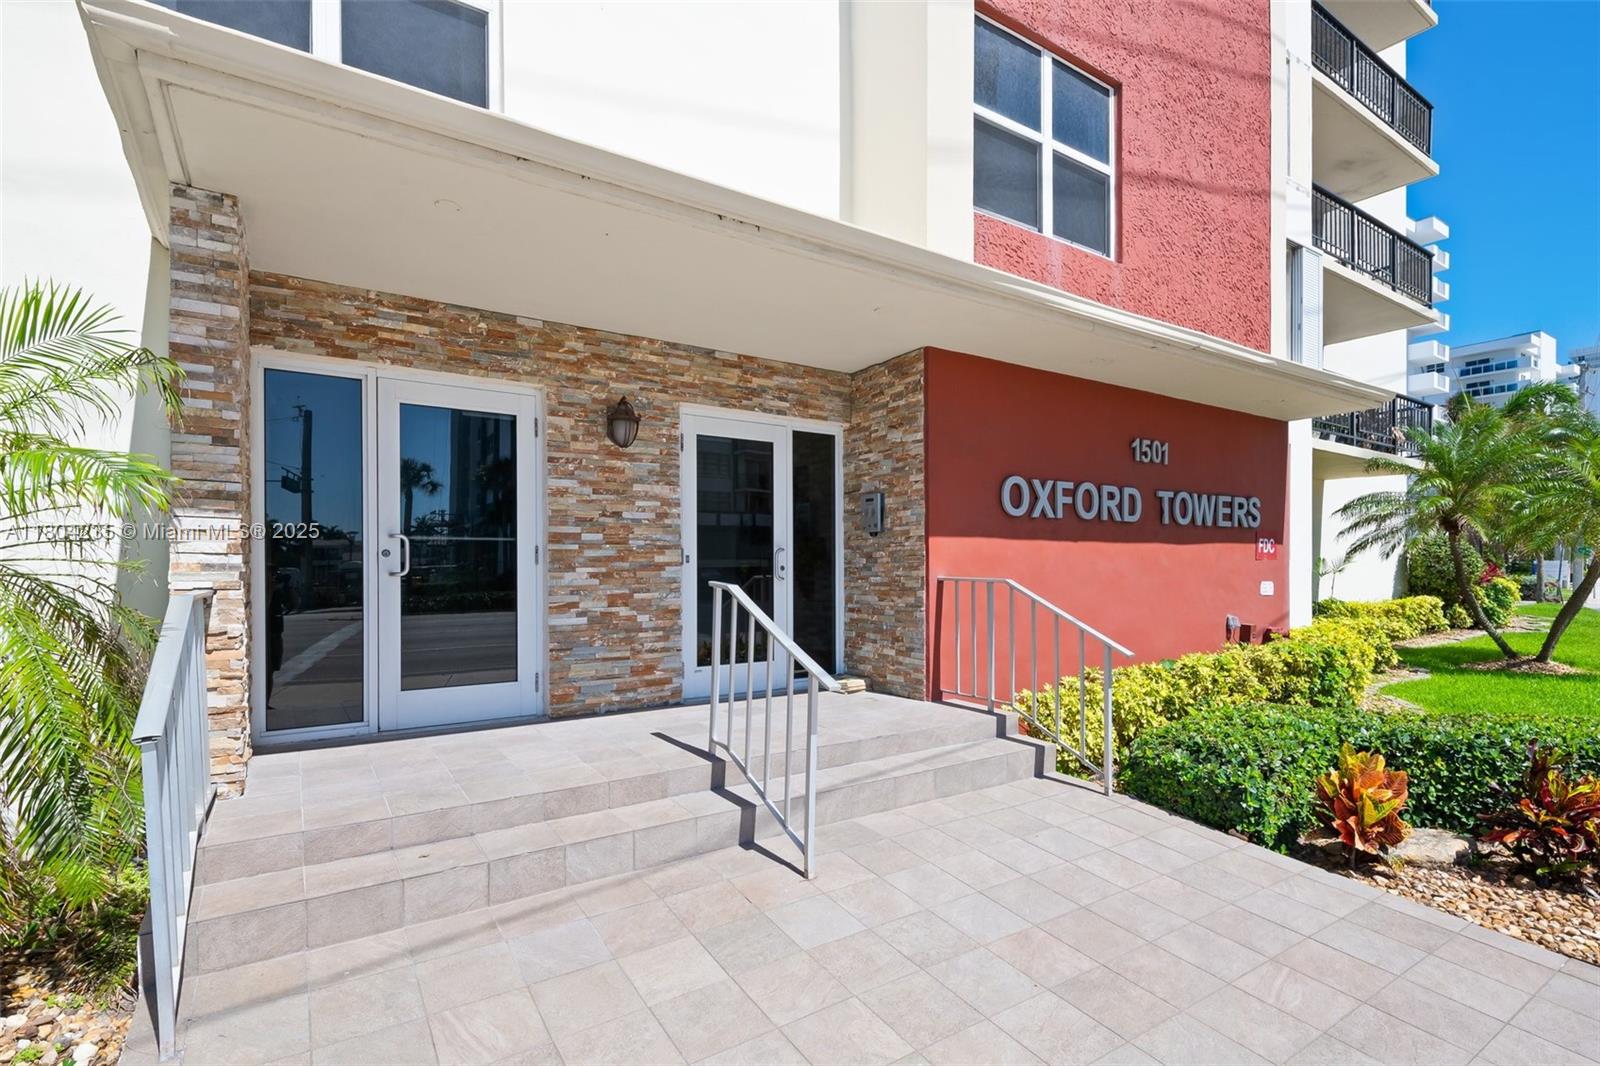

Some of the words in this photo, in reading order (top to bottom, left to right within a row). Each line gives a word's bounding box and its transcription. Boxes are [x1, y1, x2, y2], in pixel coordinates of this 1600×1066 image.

[1131, 438, 1168, 465] 1501
[1000, 475, 1142, 523] OXFORD
[1156, 490, 1262, 529] TOWERS
[1258, 538, 1275, 553] FDC
